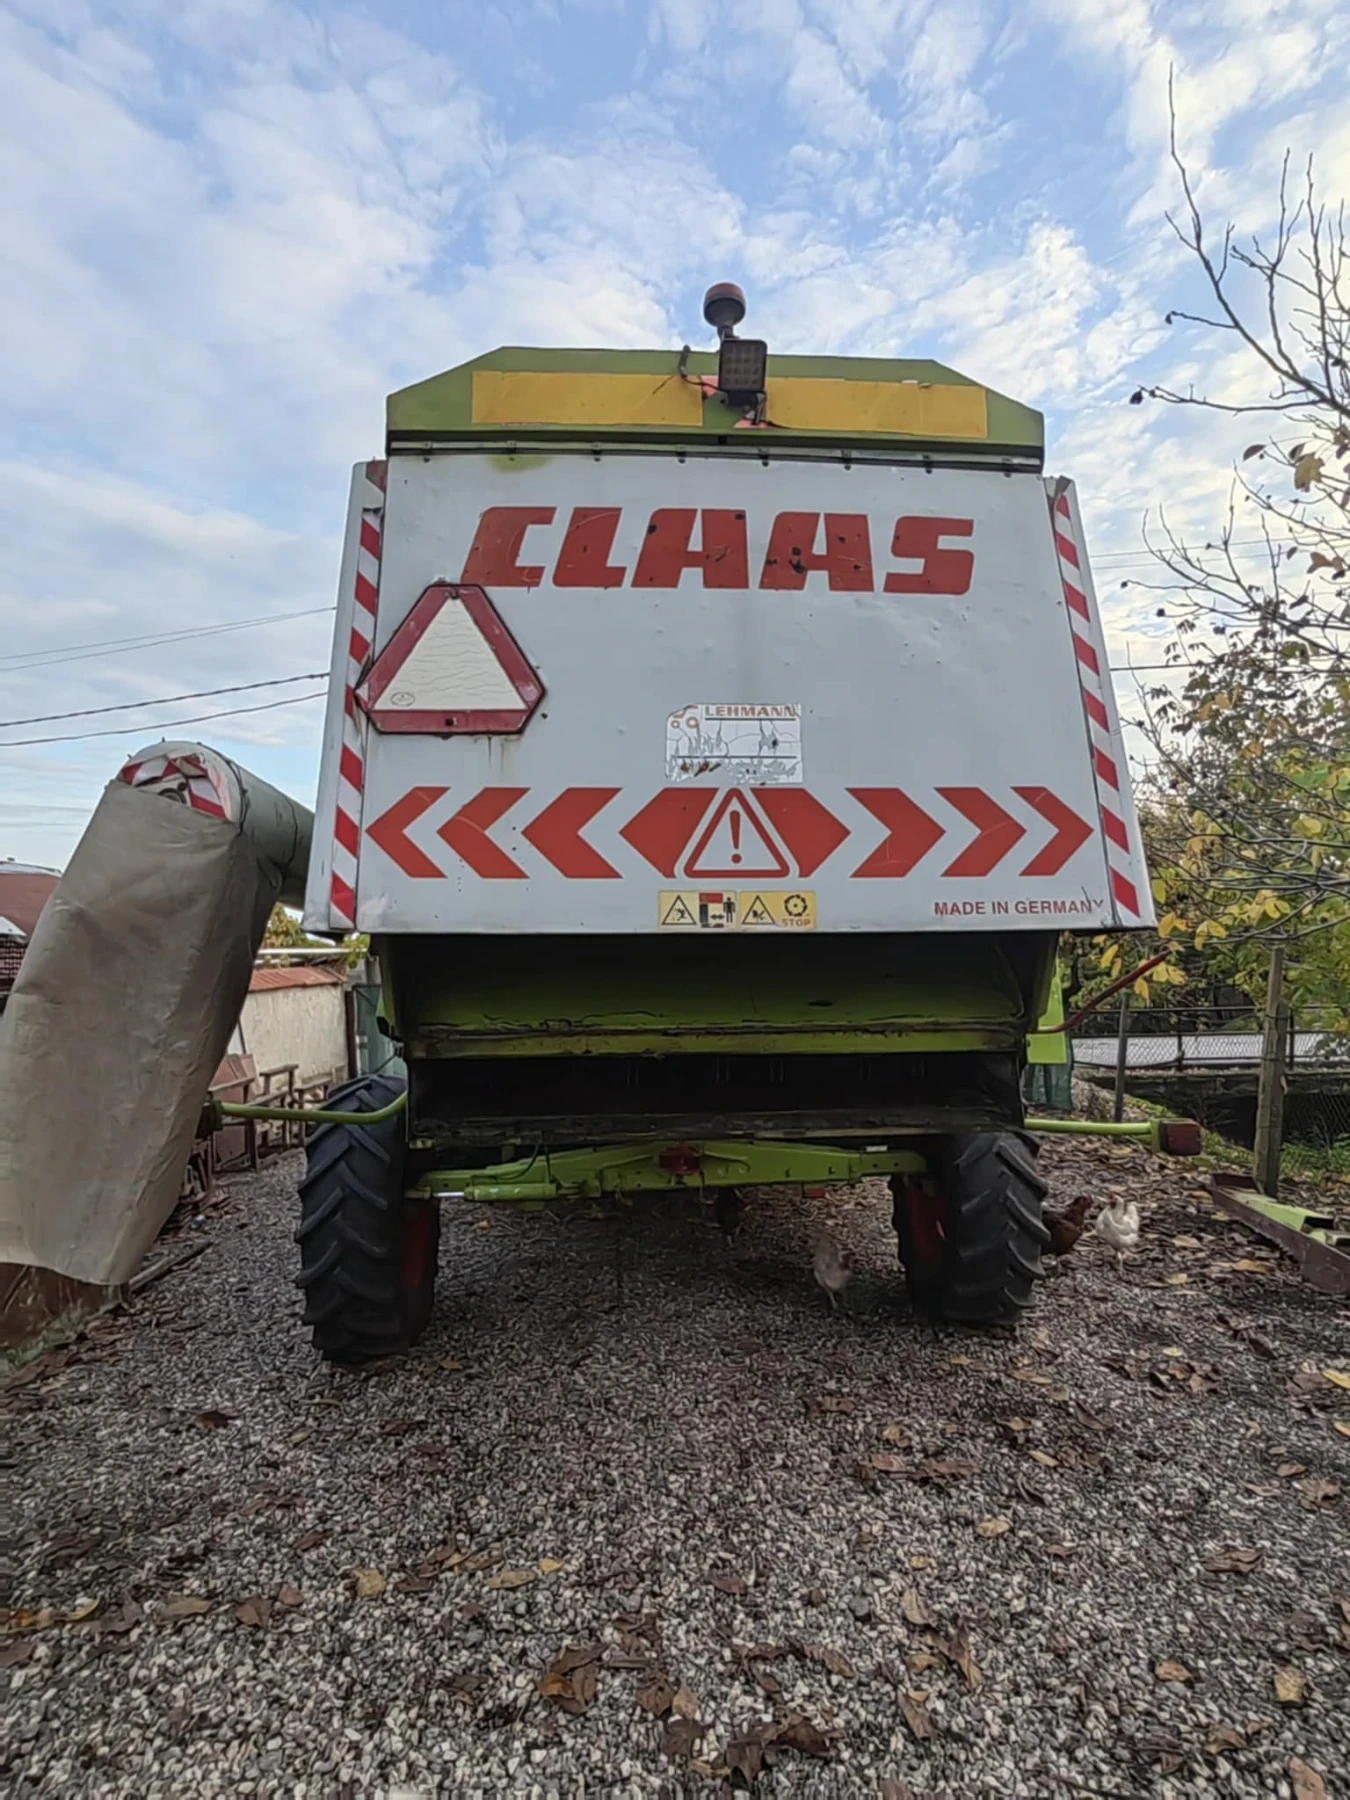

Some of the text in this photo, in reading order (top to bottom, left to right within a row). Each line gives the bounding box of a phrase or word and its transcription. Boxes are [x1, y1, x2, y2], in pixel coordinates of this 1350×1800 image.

[460, 506, 974, 595] CLAAS
[704, 705, 798, 717] LEHMANN
[934, 900, 1104, 915] MADE IN GERMANY
[781, 918, 811, 927] STOP
